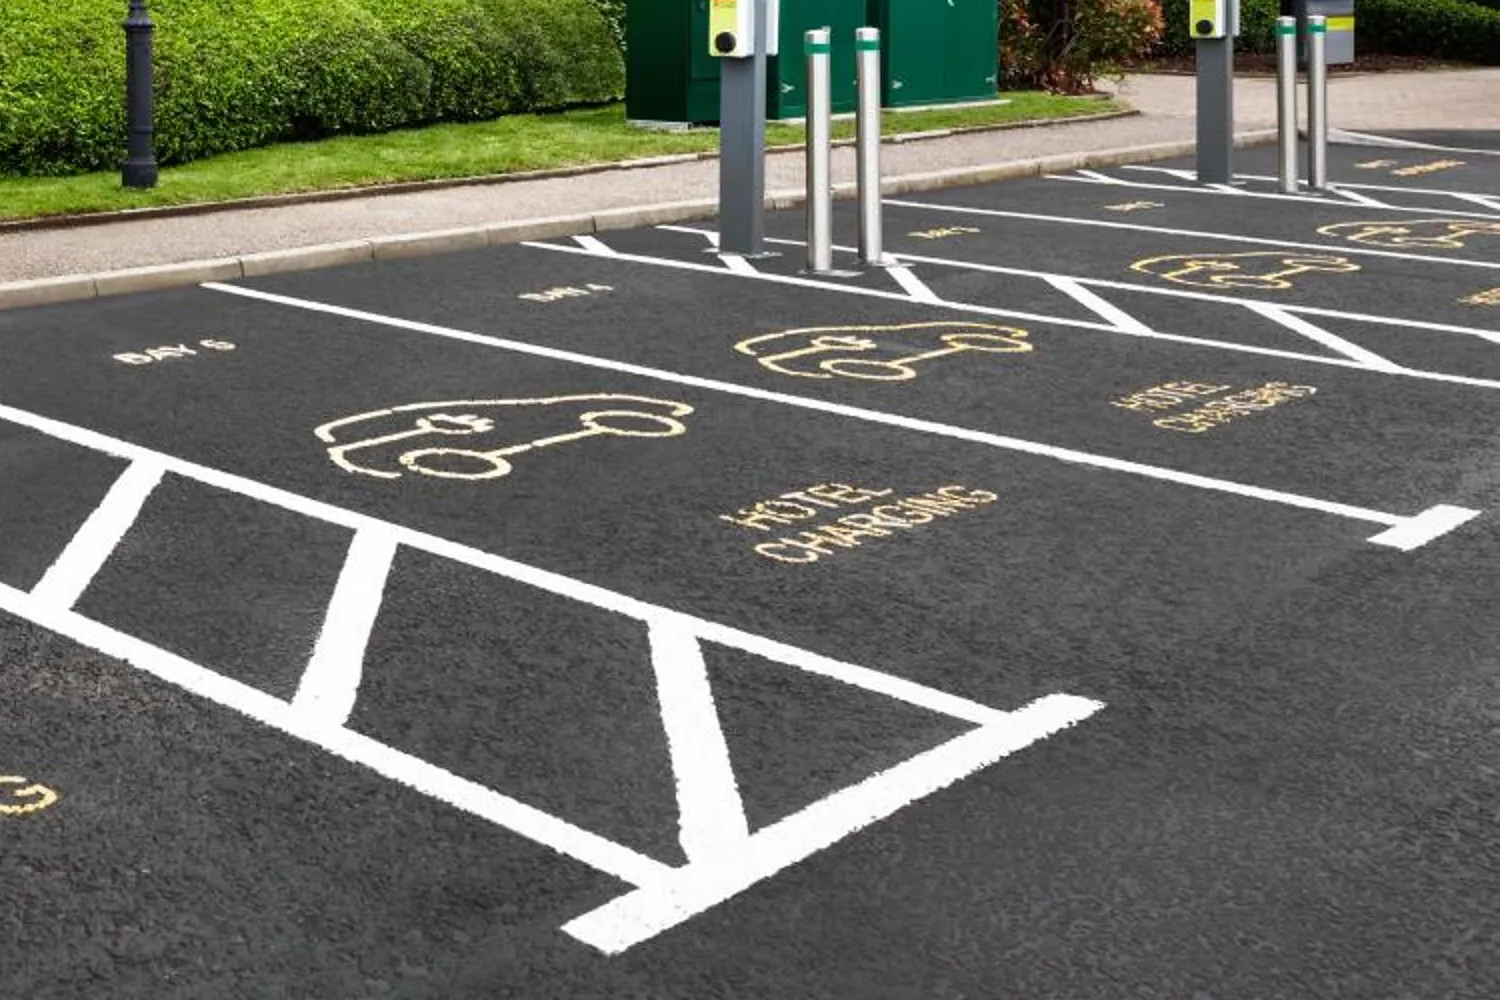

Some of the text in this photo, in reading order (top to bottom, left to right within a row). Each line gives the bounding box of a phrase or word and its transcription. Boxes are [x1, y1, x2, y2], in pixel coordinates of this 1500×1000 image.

[112, 343, 197, 364] BAY
[1108, 379, 1232, 413] HOTEL
[719, 482, 893, 531] HOTEL
[754, 485, 998, 564] CHARGING
